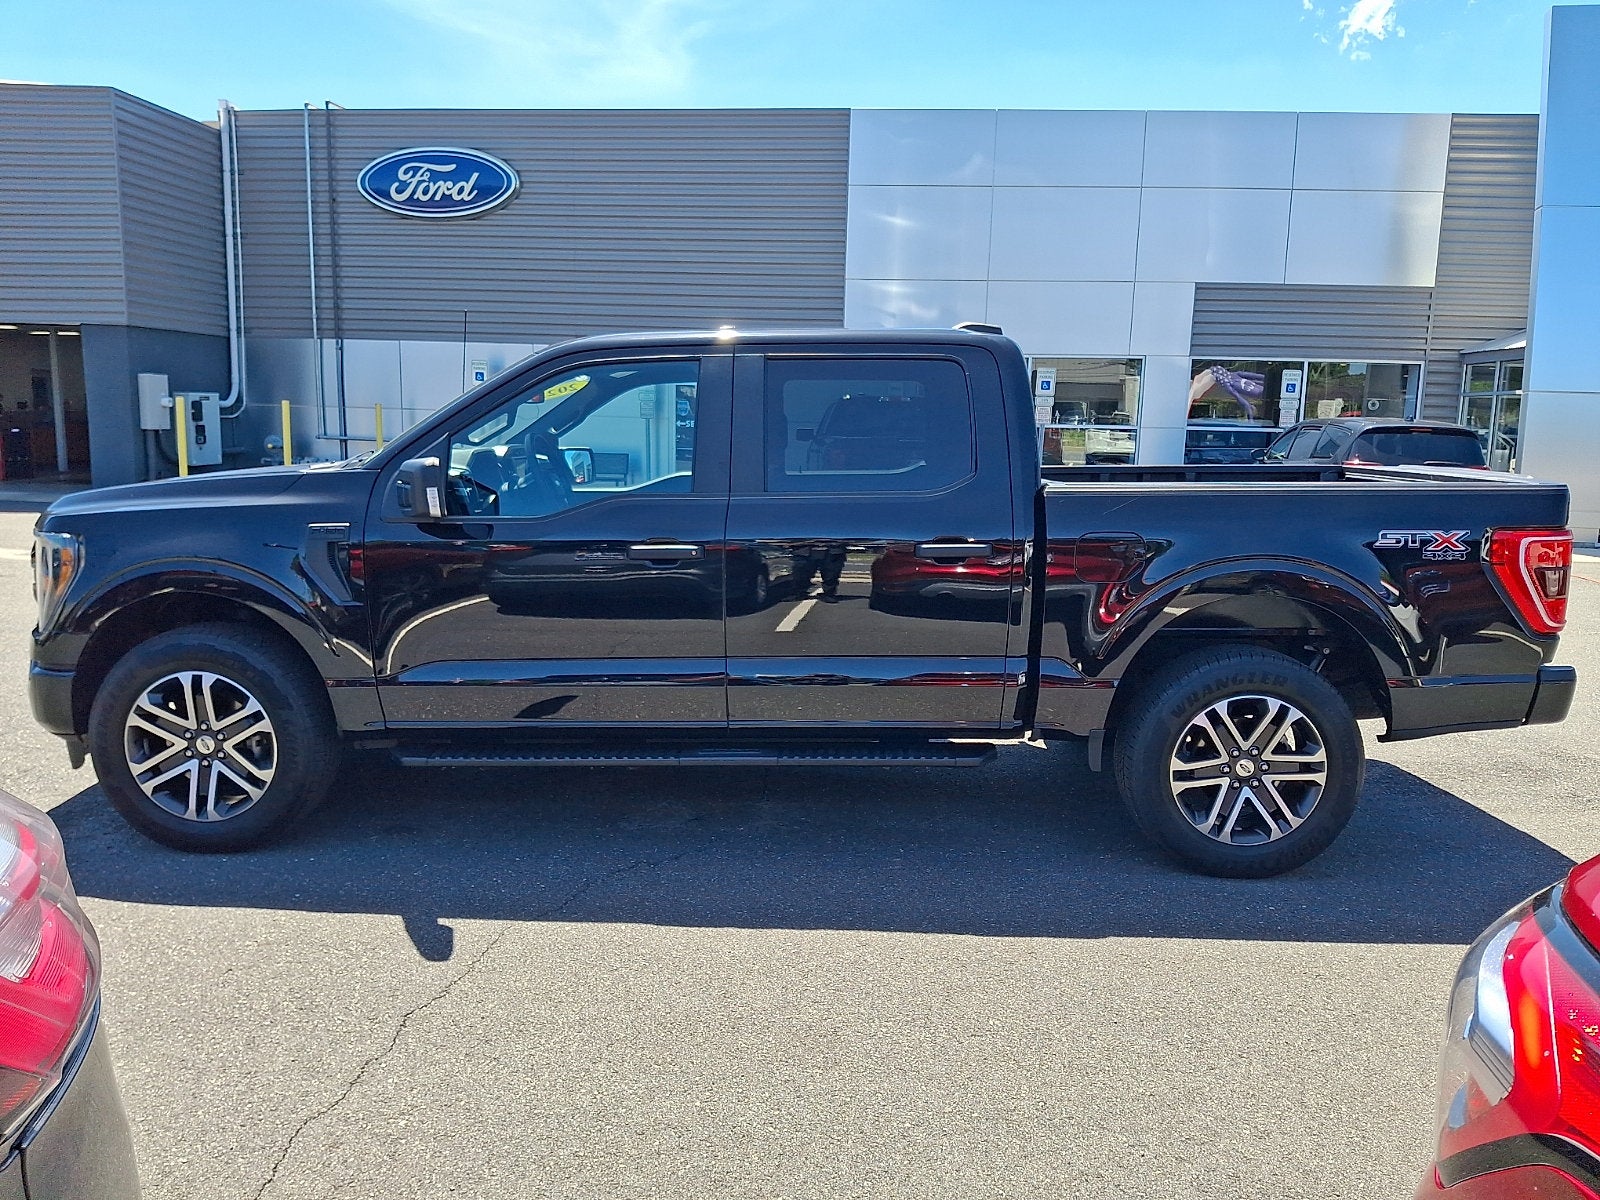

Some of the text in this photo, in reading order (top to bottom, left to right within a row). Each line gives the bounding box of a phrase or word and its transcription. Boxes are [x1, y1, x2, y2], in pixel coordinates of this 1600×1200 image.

[390, 162, 480, 202] Ford
[1373, 529, 1472, 553] STX
[1170, 671, 1289, 718] WRANGLER
